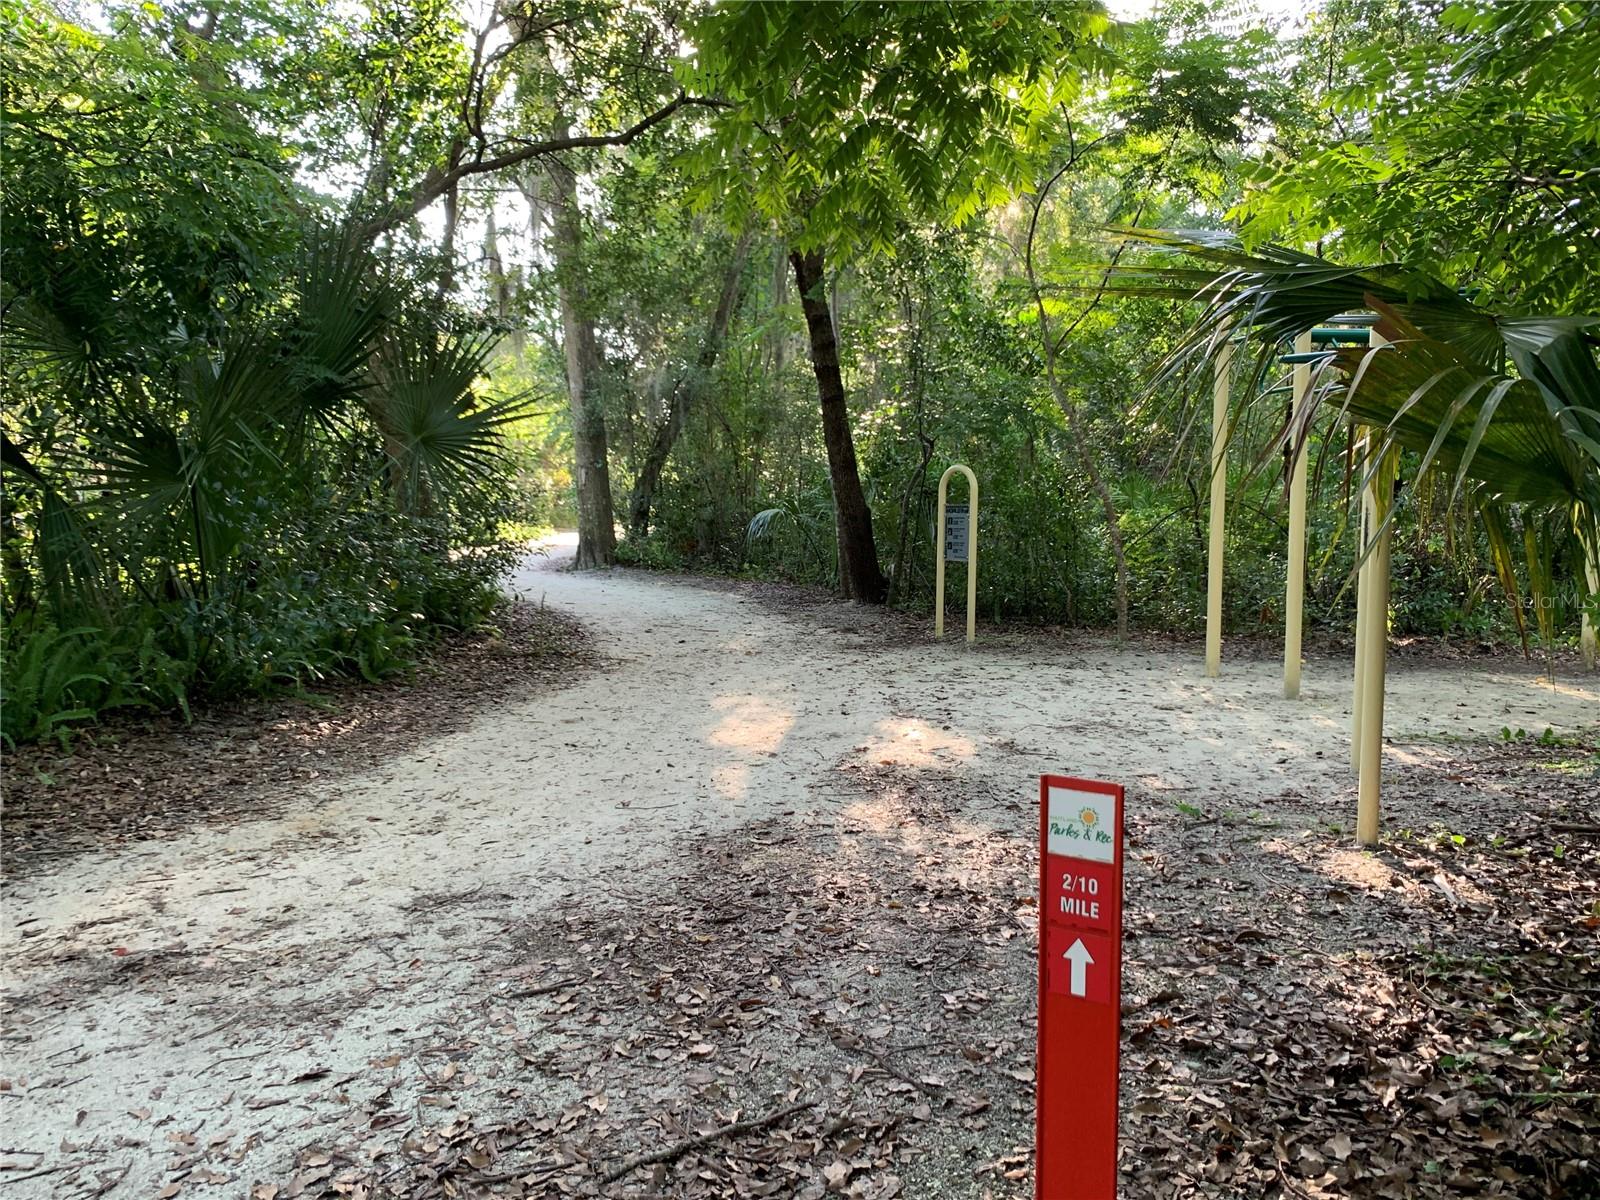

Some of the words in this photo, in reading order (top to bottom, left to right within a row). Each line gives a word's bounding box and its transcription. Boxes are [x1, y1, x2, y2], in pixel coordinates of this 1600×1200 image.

[1049, 823, 1080, 839] Parks
[1083, 828, 1091, 840] &
[1096, 830, 1112, 843] Rec
[1062, 873, 1098, 895] 2/10
[1060, 896, 1099, 919] MILE
